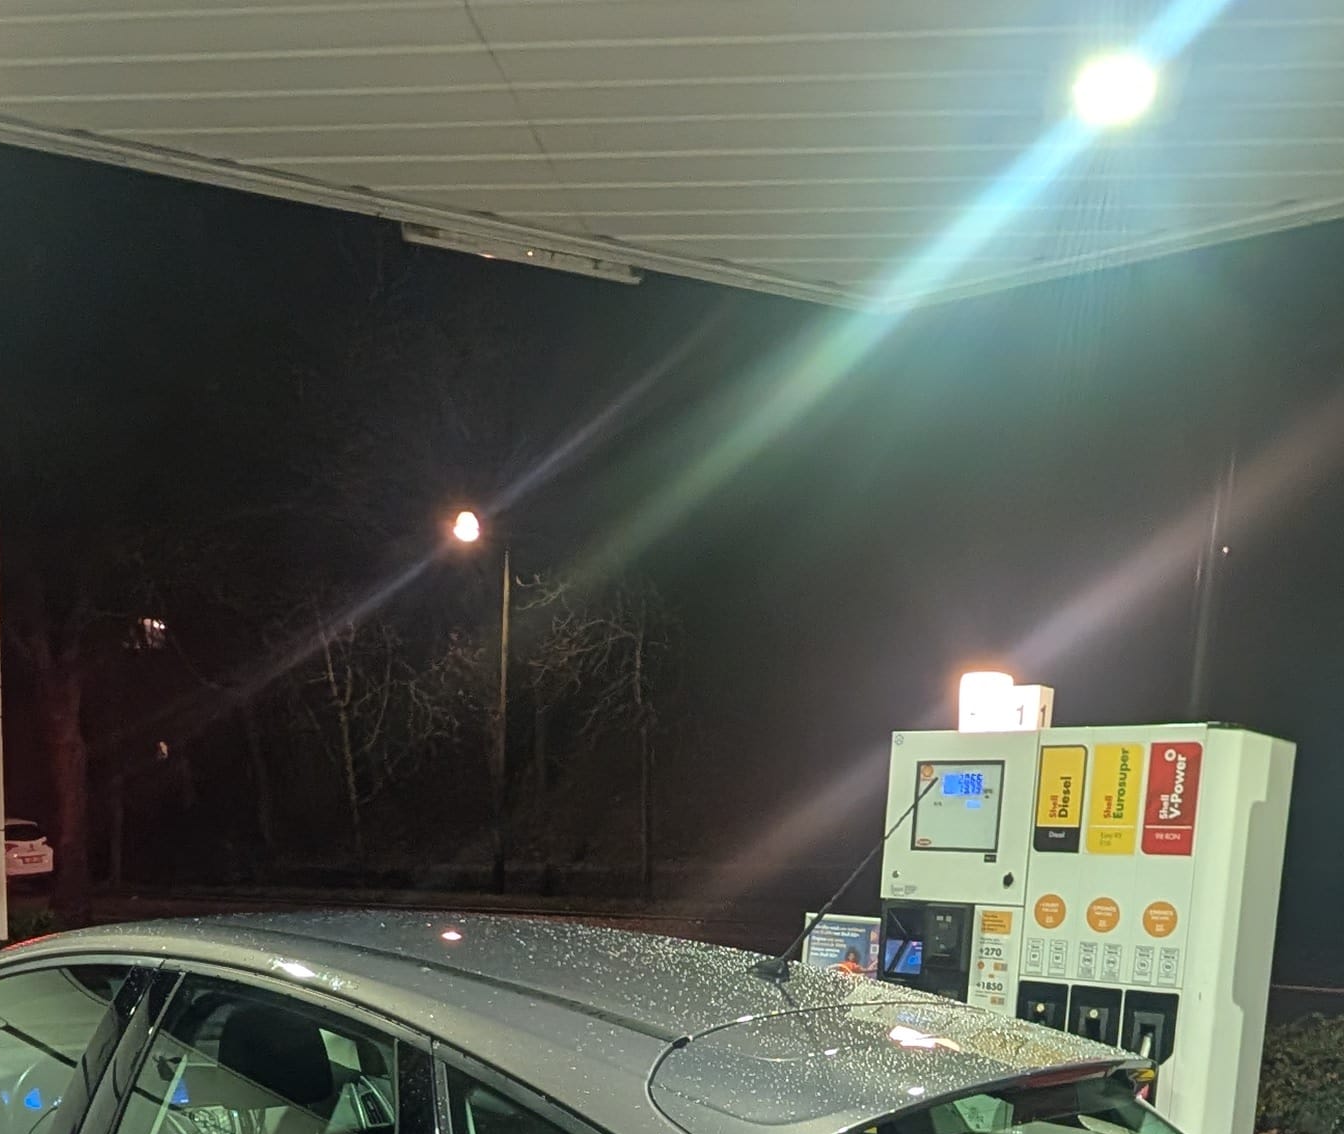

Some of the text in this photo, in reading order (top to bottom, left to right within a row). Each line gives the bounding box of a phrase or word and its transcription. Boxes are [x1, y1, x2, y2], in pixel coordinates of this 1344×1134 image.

[1016, 704, 1025, 726] 1
[1058, 776, 1072, 818] Diesel
[1113, 747, 1131, 820] Eurosuper
[1159, 794, 1170, 820] Shell
